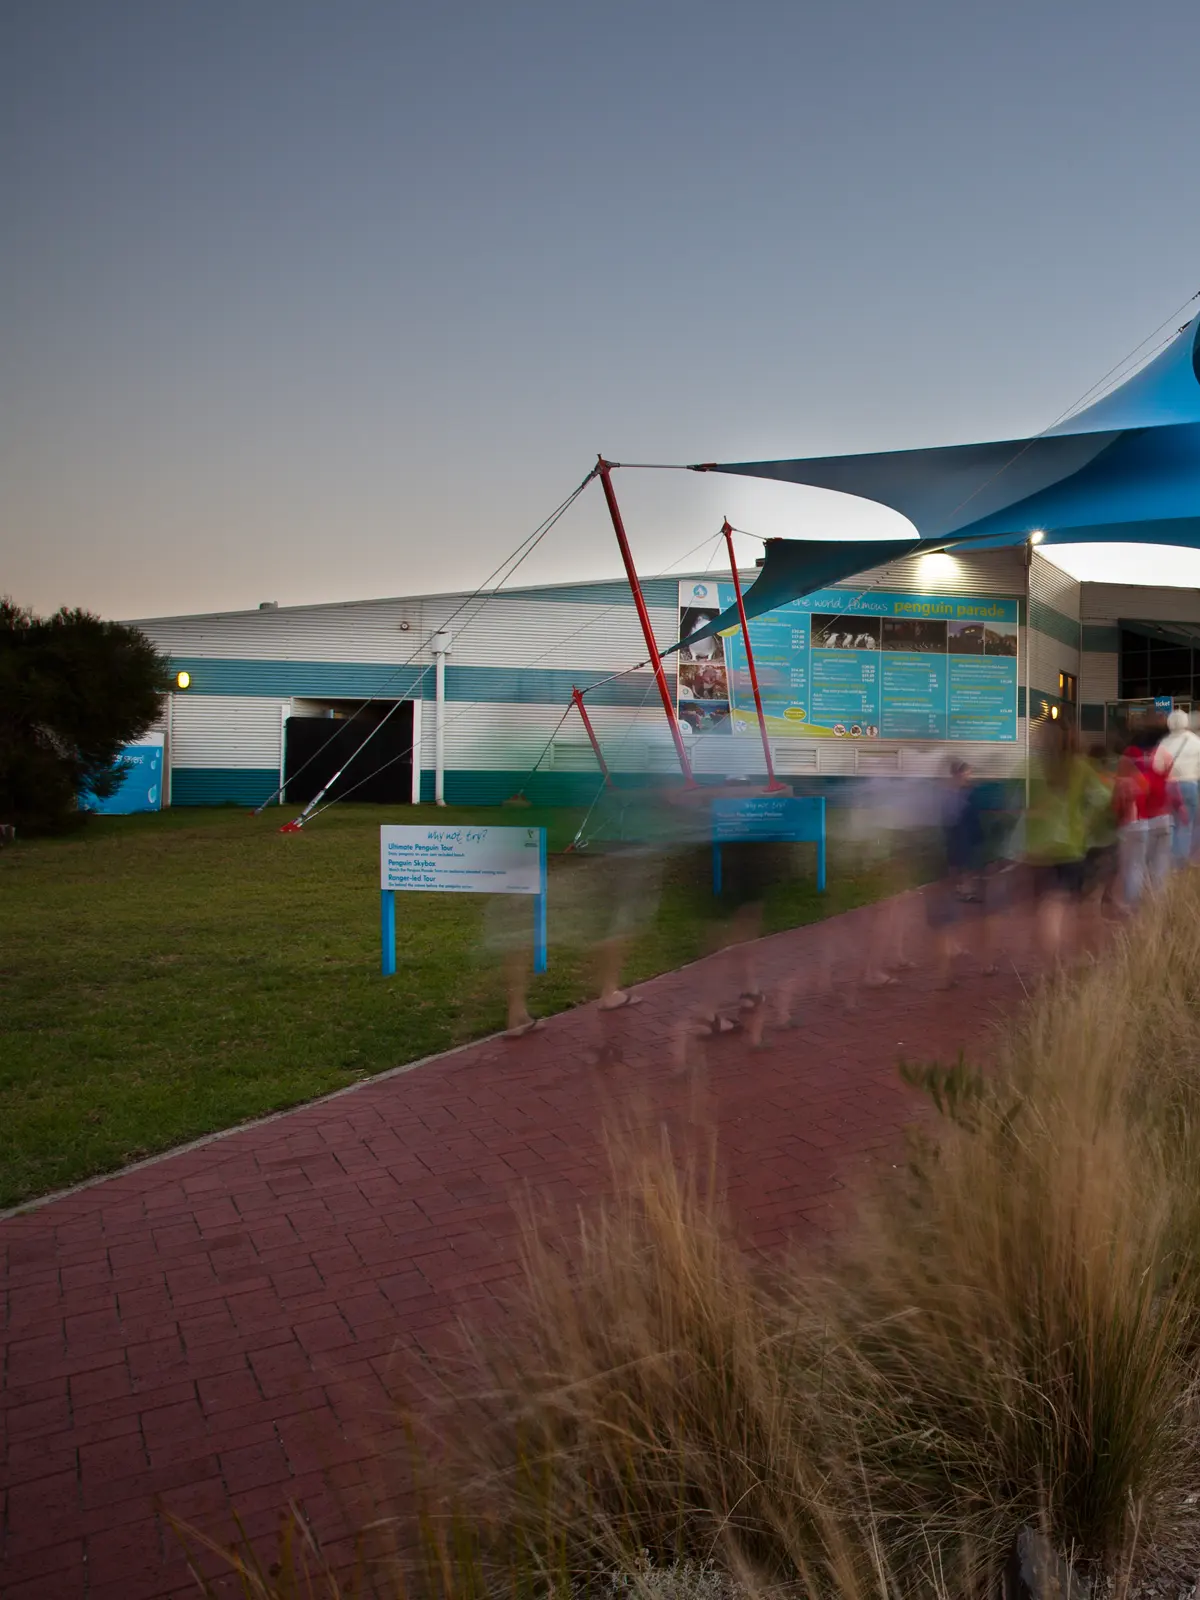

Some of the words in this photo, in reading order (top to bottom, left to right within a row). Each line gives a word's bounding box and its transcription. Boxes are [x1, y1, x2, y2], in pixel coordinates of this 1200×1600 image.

[814, 597, 843, 608] world
[848, 597, 888, 611] famous
[894, 601, 953, 616] penguin
[957, 603, 1005, 618] parade
[427, 830, 445, 842] why
[446, 828, 462, 844] not
[466, 829, 488, 843] try?
[388, 842, 413, 850] Ultimate
[414, 843, 439, 852] Penguin
[388, 859, 412, 867] Penguin
[413, 859, 436, 867] Skybox
[388, 874, 421, 882] Ranger-led
[423, 874, 436, 882] Tour
